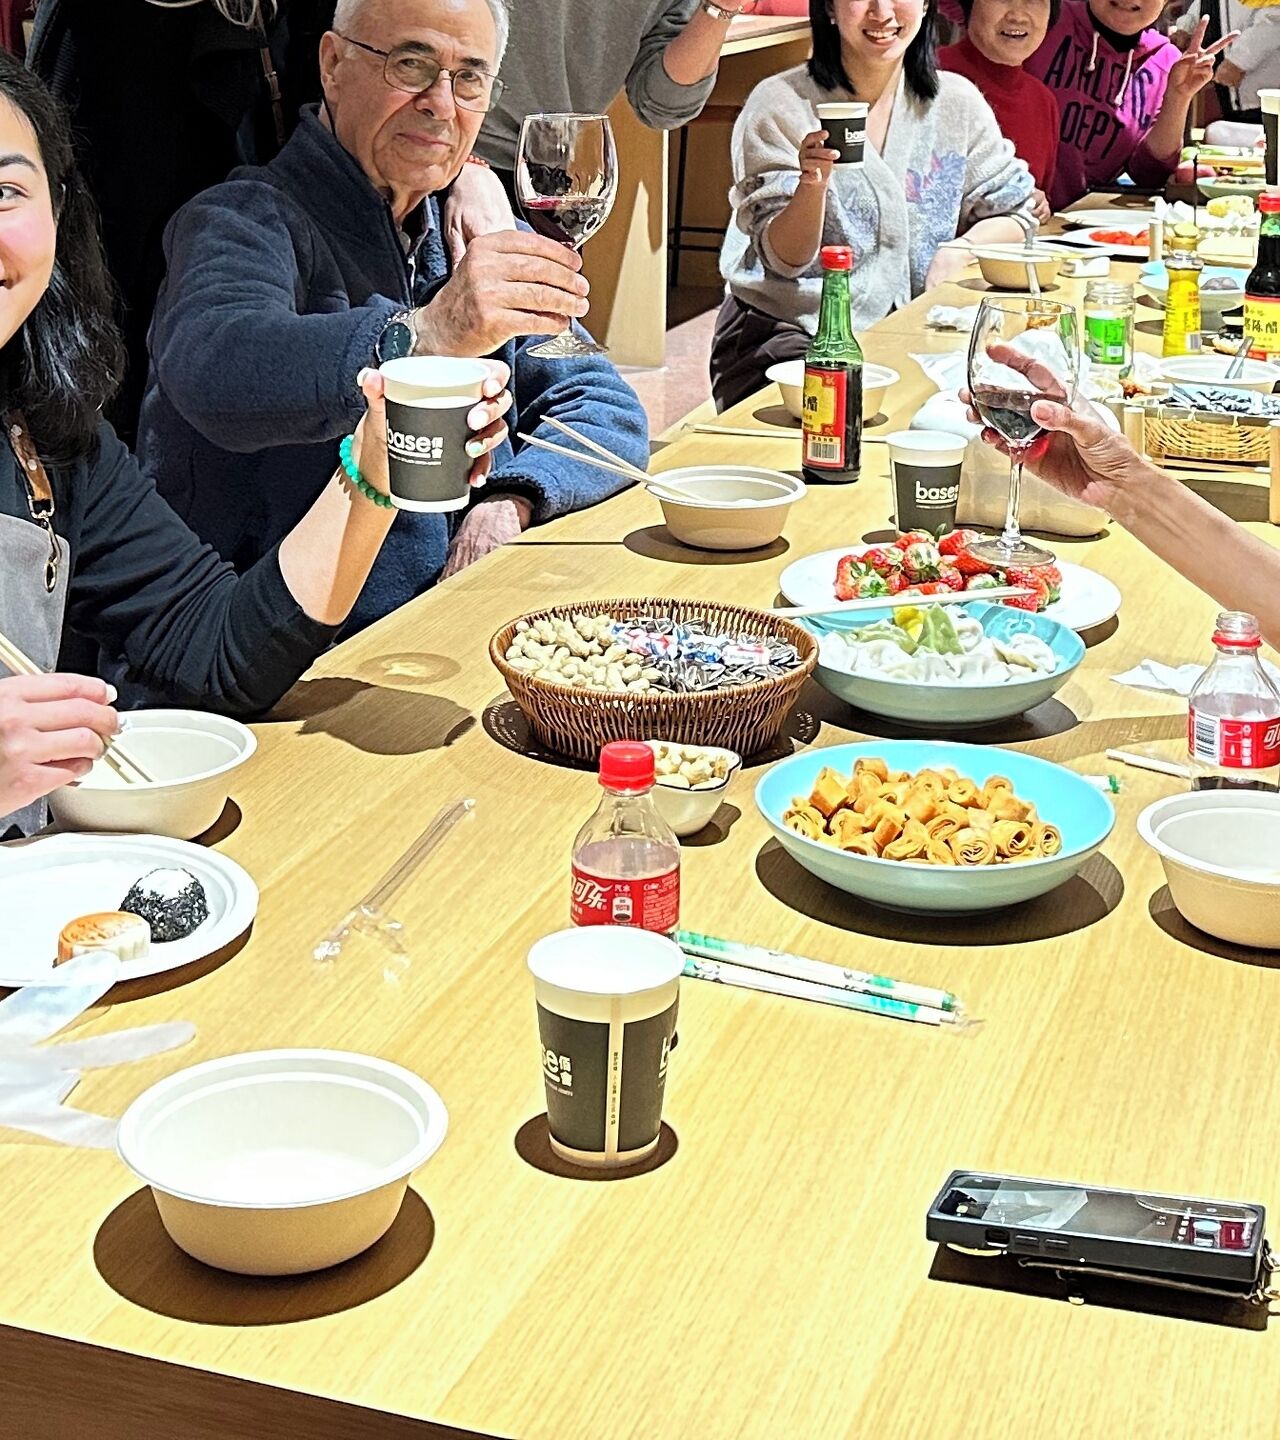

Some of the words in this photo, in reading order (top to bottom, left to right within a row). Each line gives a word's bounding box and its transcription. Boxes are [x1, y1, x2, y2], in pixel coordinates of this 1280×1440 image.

[1042, 34, 1154, 131] ATHLEIC
[1060, 101, 1126, 160] DEPT
[386, 418, 431, 453] base
[915, 480, 955, 500] base
